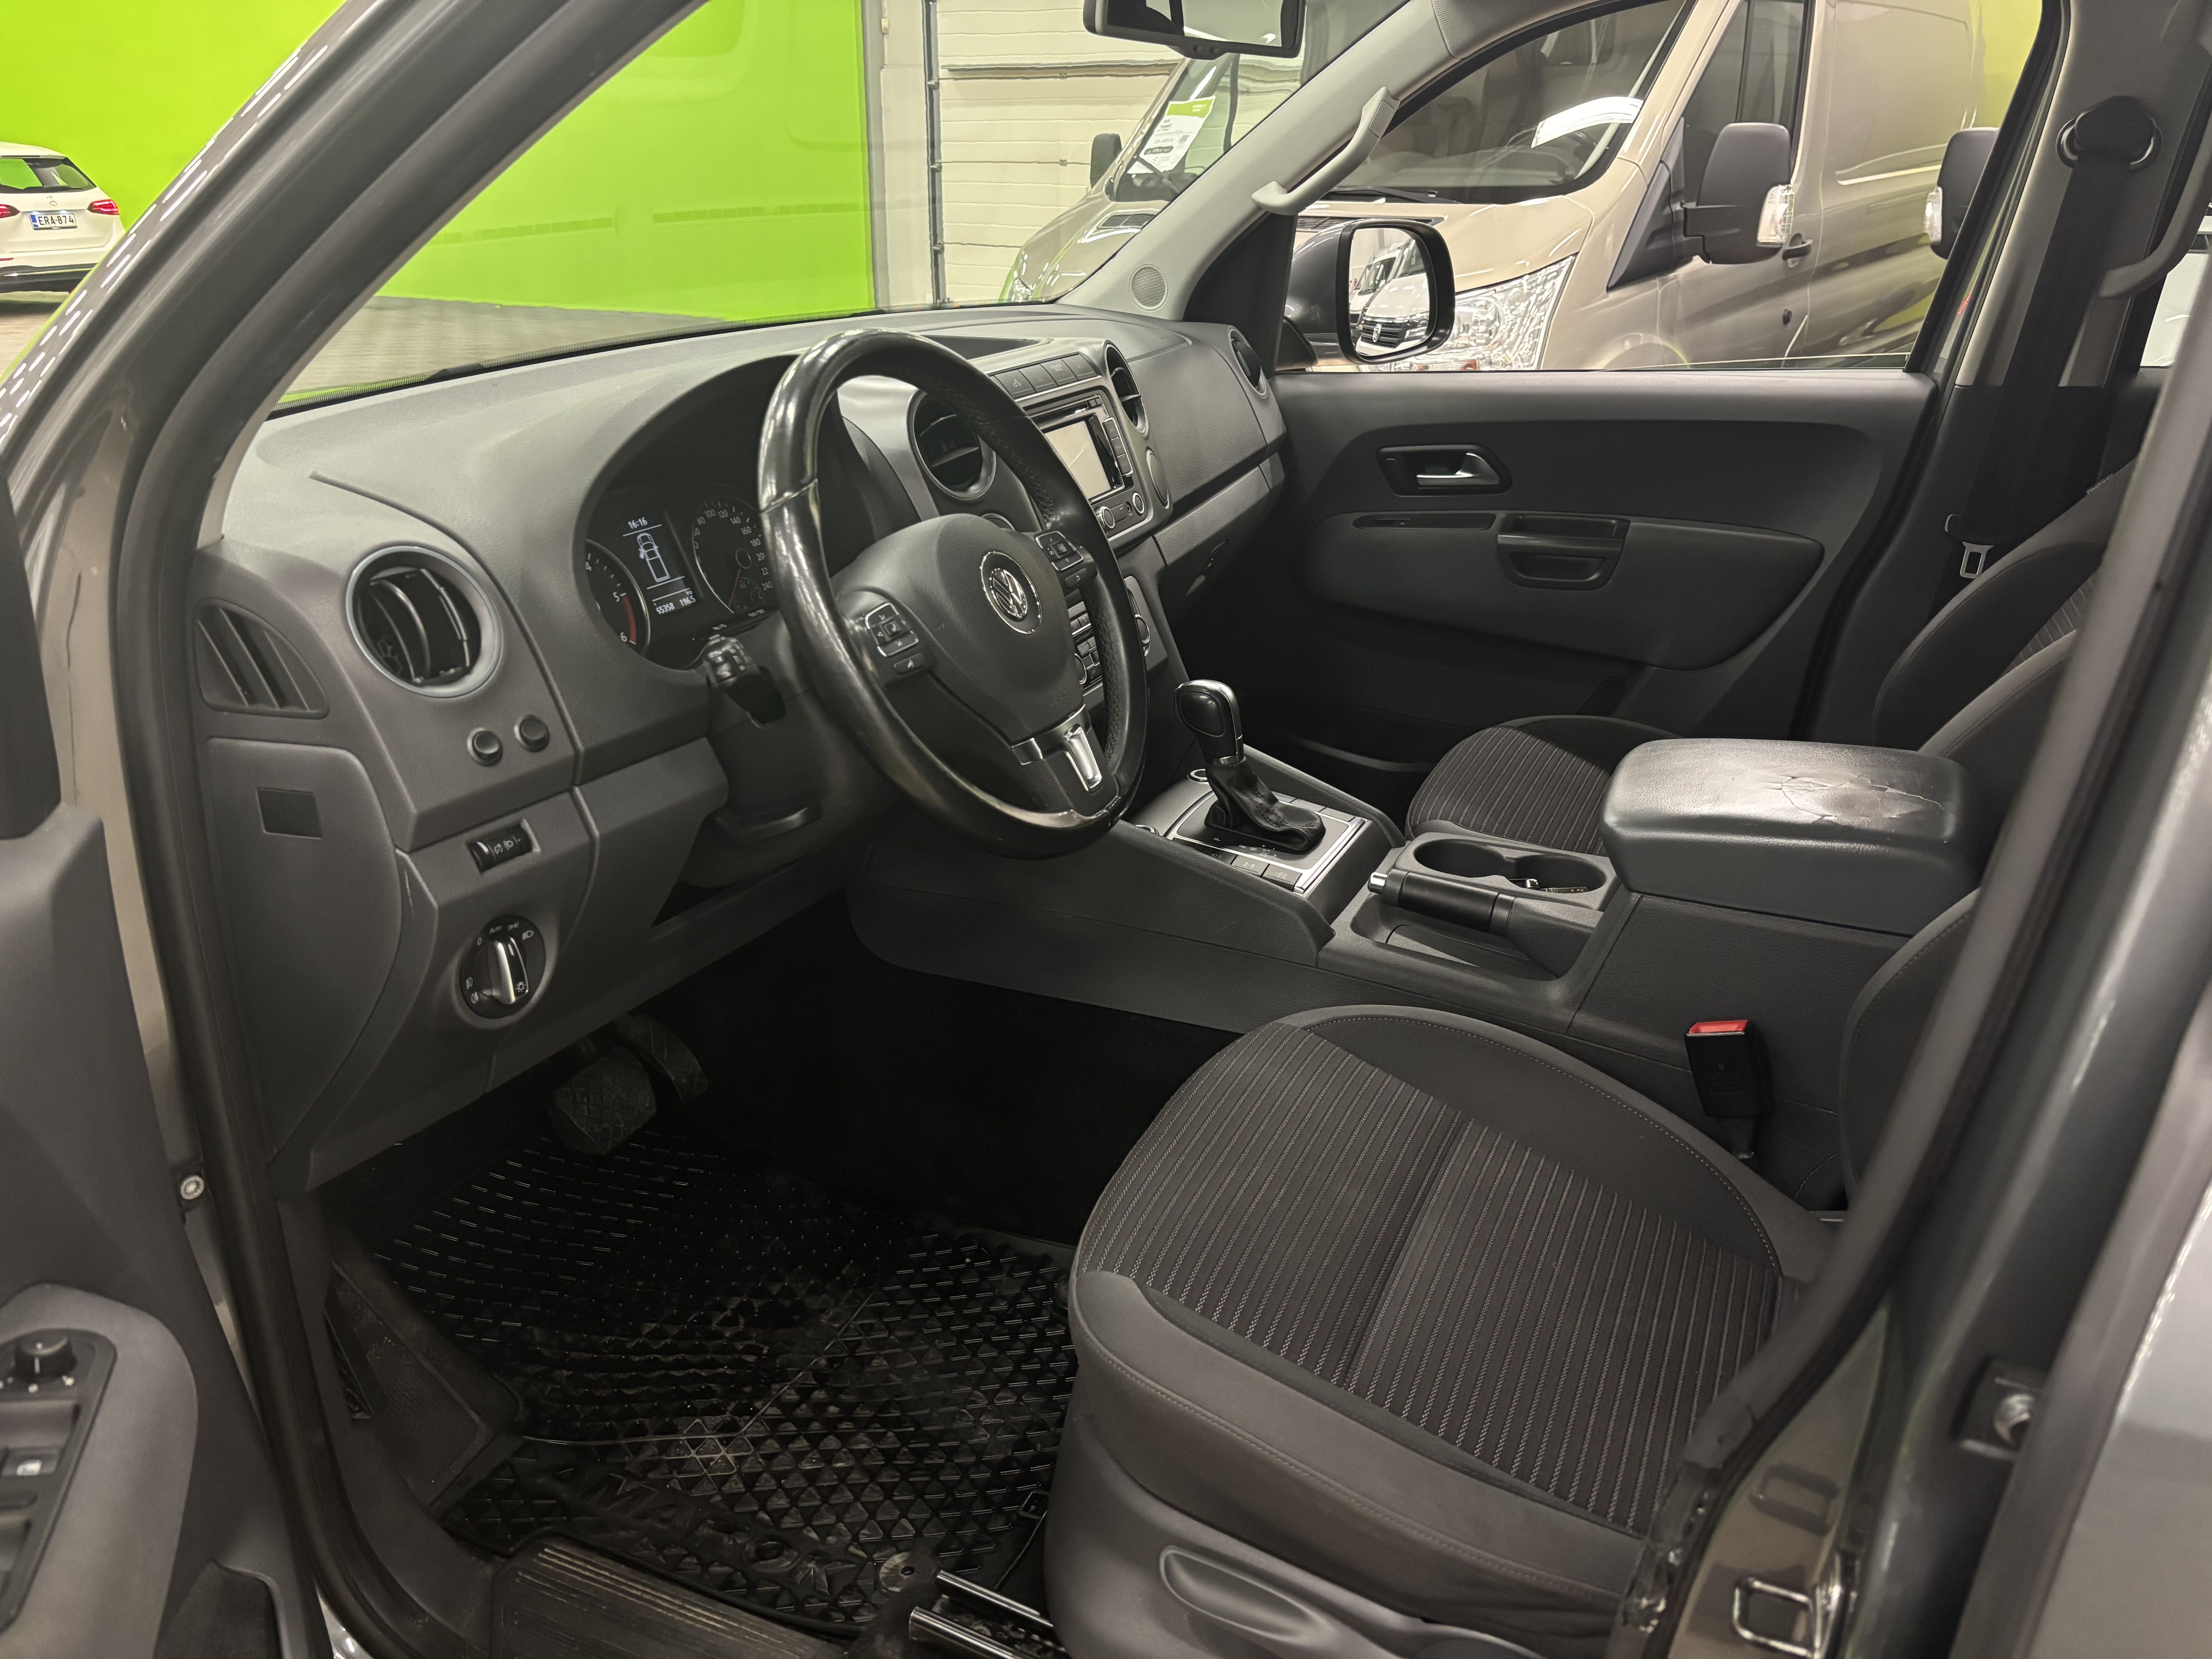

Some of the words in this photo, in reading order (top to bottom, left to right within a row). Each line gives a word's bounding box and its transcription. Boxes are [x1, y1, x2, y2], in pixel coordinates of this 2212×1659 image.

[38, 215, 74, 225] ERA-874
[718, 510, 728, 518] 120
[628, 517, 647, 529] 16:16
[730, 516, 741, 525] 140
[741, 526, 752, 535] 160
[750, 538, 761, 547] 180
[586, 562, 592, 571] 4
[761, 581, 773, 591] 240
[613, 592, 620, 602] 5
[620, 632, 627, 642] 6
